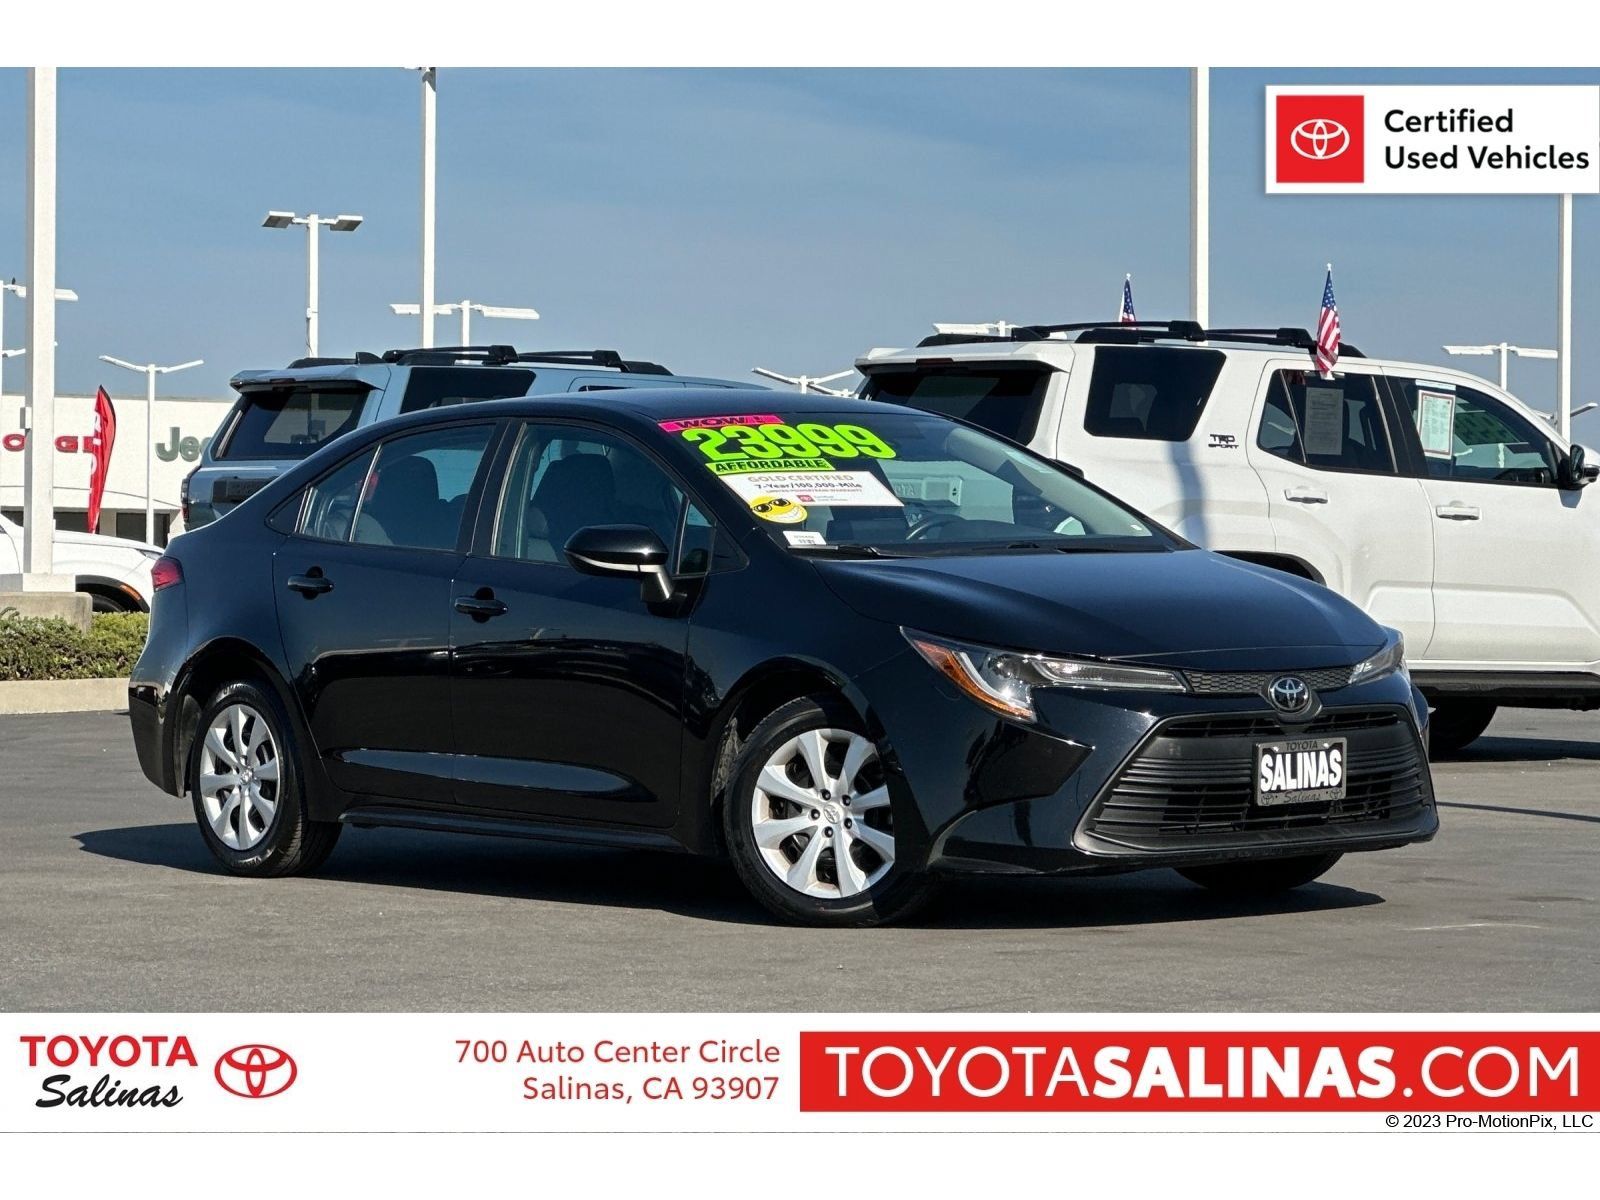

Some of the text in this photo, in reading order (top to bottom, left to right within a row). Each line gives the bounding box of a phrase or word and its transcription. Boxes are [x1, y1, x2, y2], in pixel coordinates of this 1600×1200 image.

[677, 416, 745, 428] WOW
[155, 426, 212, 462] Je
[682, 424, 897, 461] 23999
[1209, 433, 1236, 444] TRD
[715, 458, 824, 472] AFFORDABLE
[747, 474, 787, 483] GOLD
[1286, 741, 1318, 751] TOYOTA
[1260, 749, 1342, 792] SALINAS
